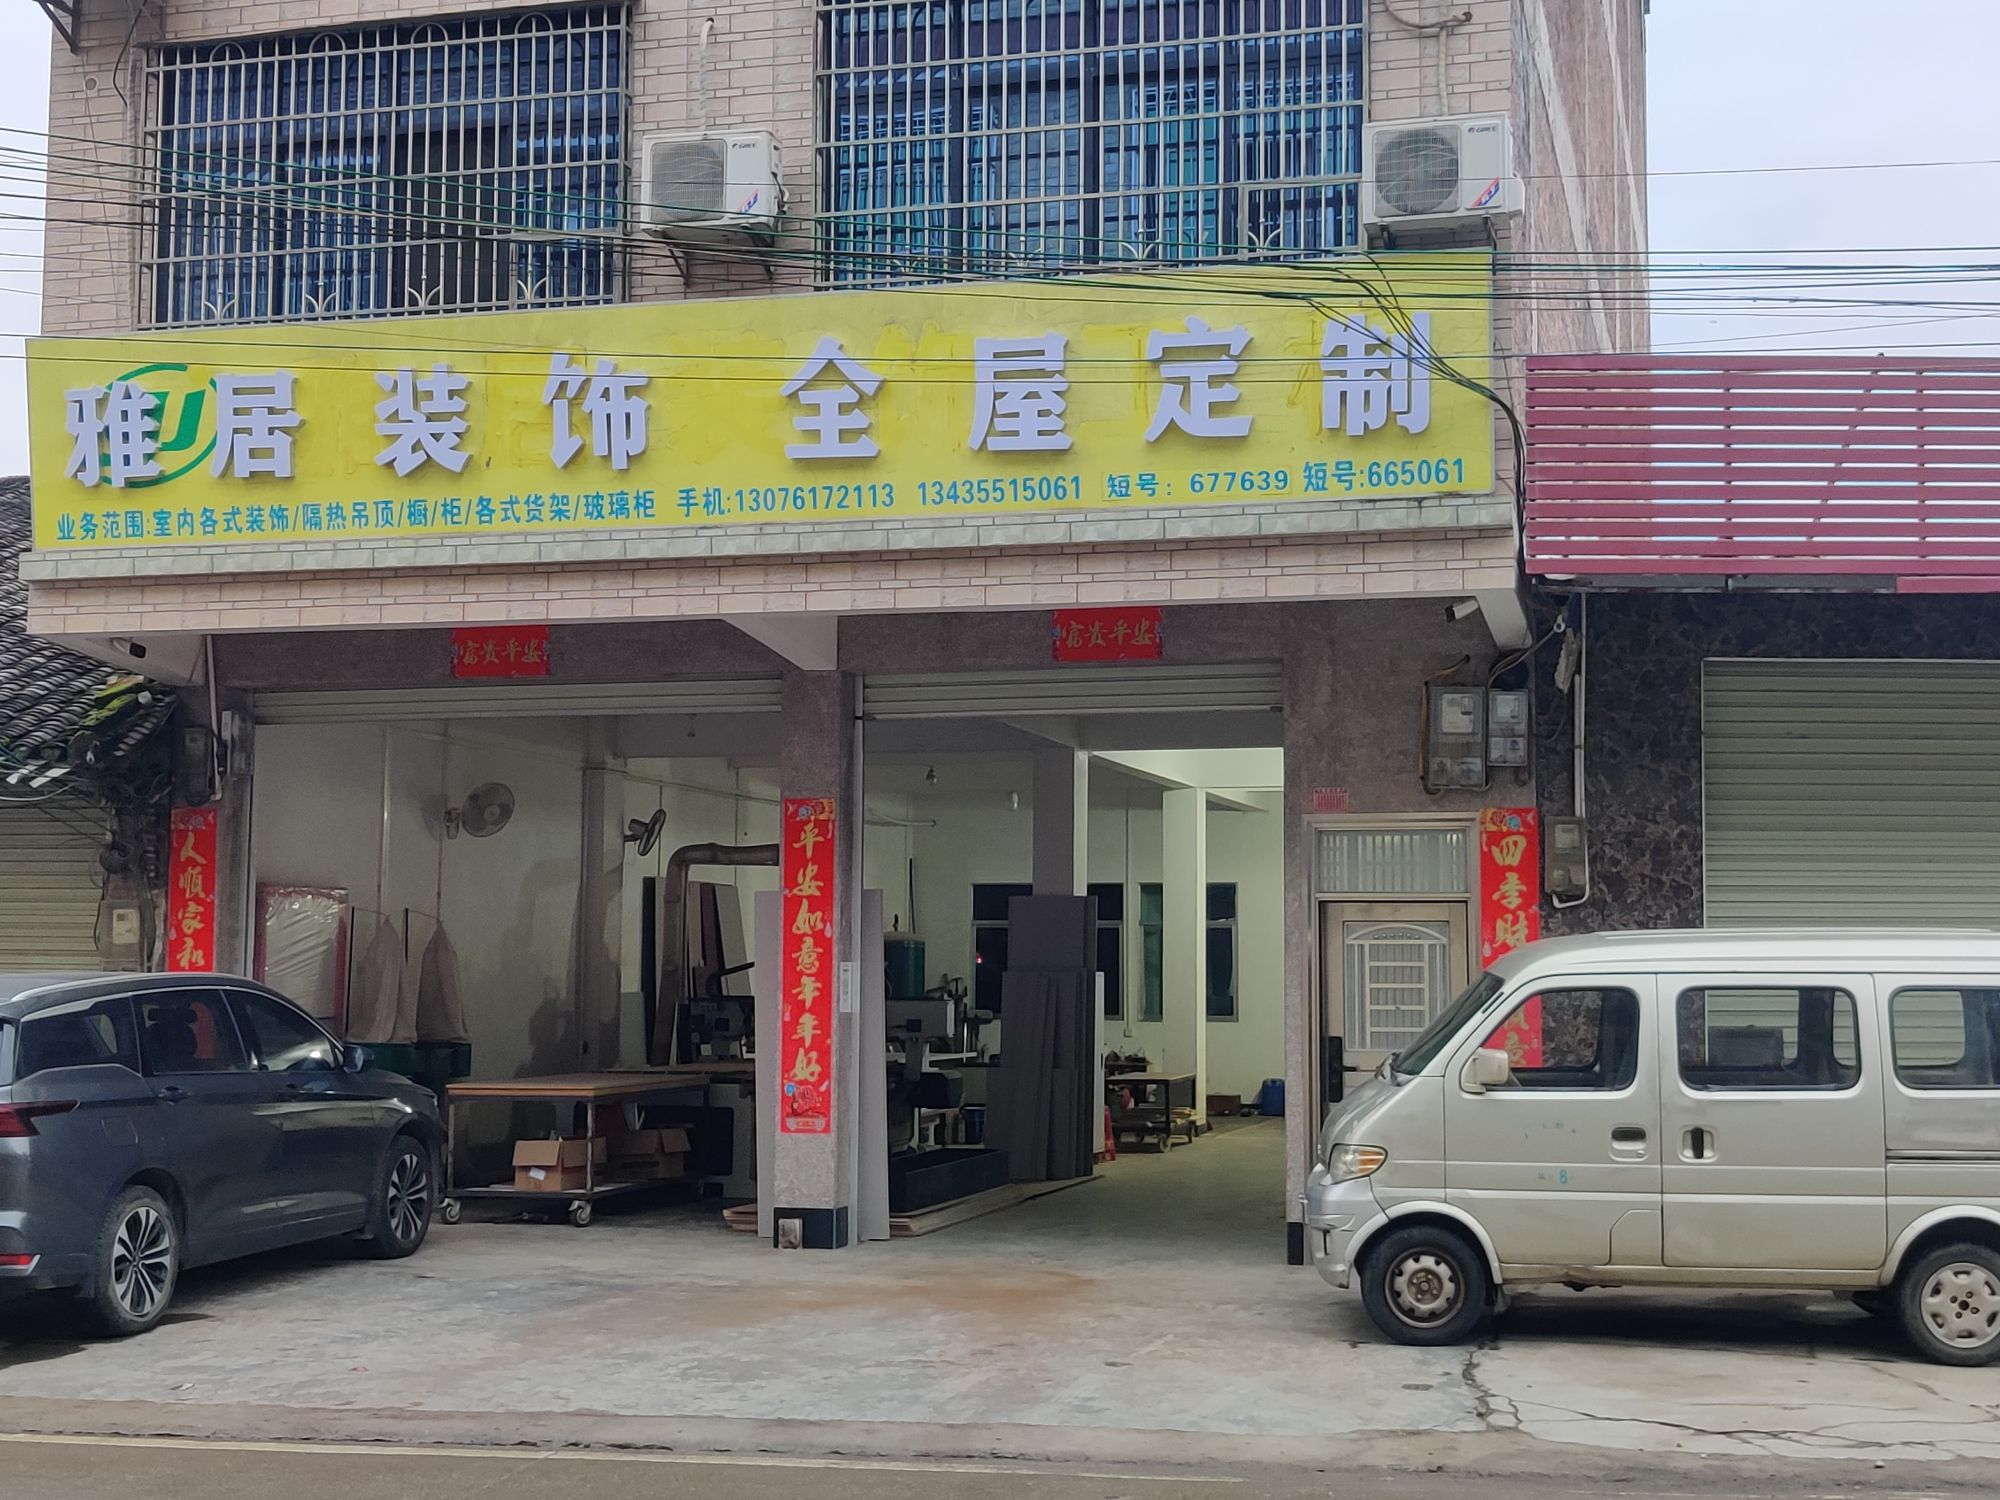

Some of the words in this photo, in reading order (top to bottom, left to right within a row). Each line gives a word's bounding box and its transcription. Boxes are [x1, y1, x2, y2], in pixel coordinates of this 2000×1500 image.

[64, 352, 650, 488] 雅居装饰
[781, 312, 1432, 461] 全屋定制
[677, 482, 895, 518] 手机:13076172113
[917, 475, 1081, 506] 13435515061
[1303, 458, 1464, 492] 短号:665061
